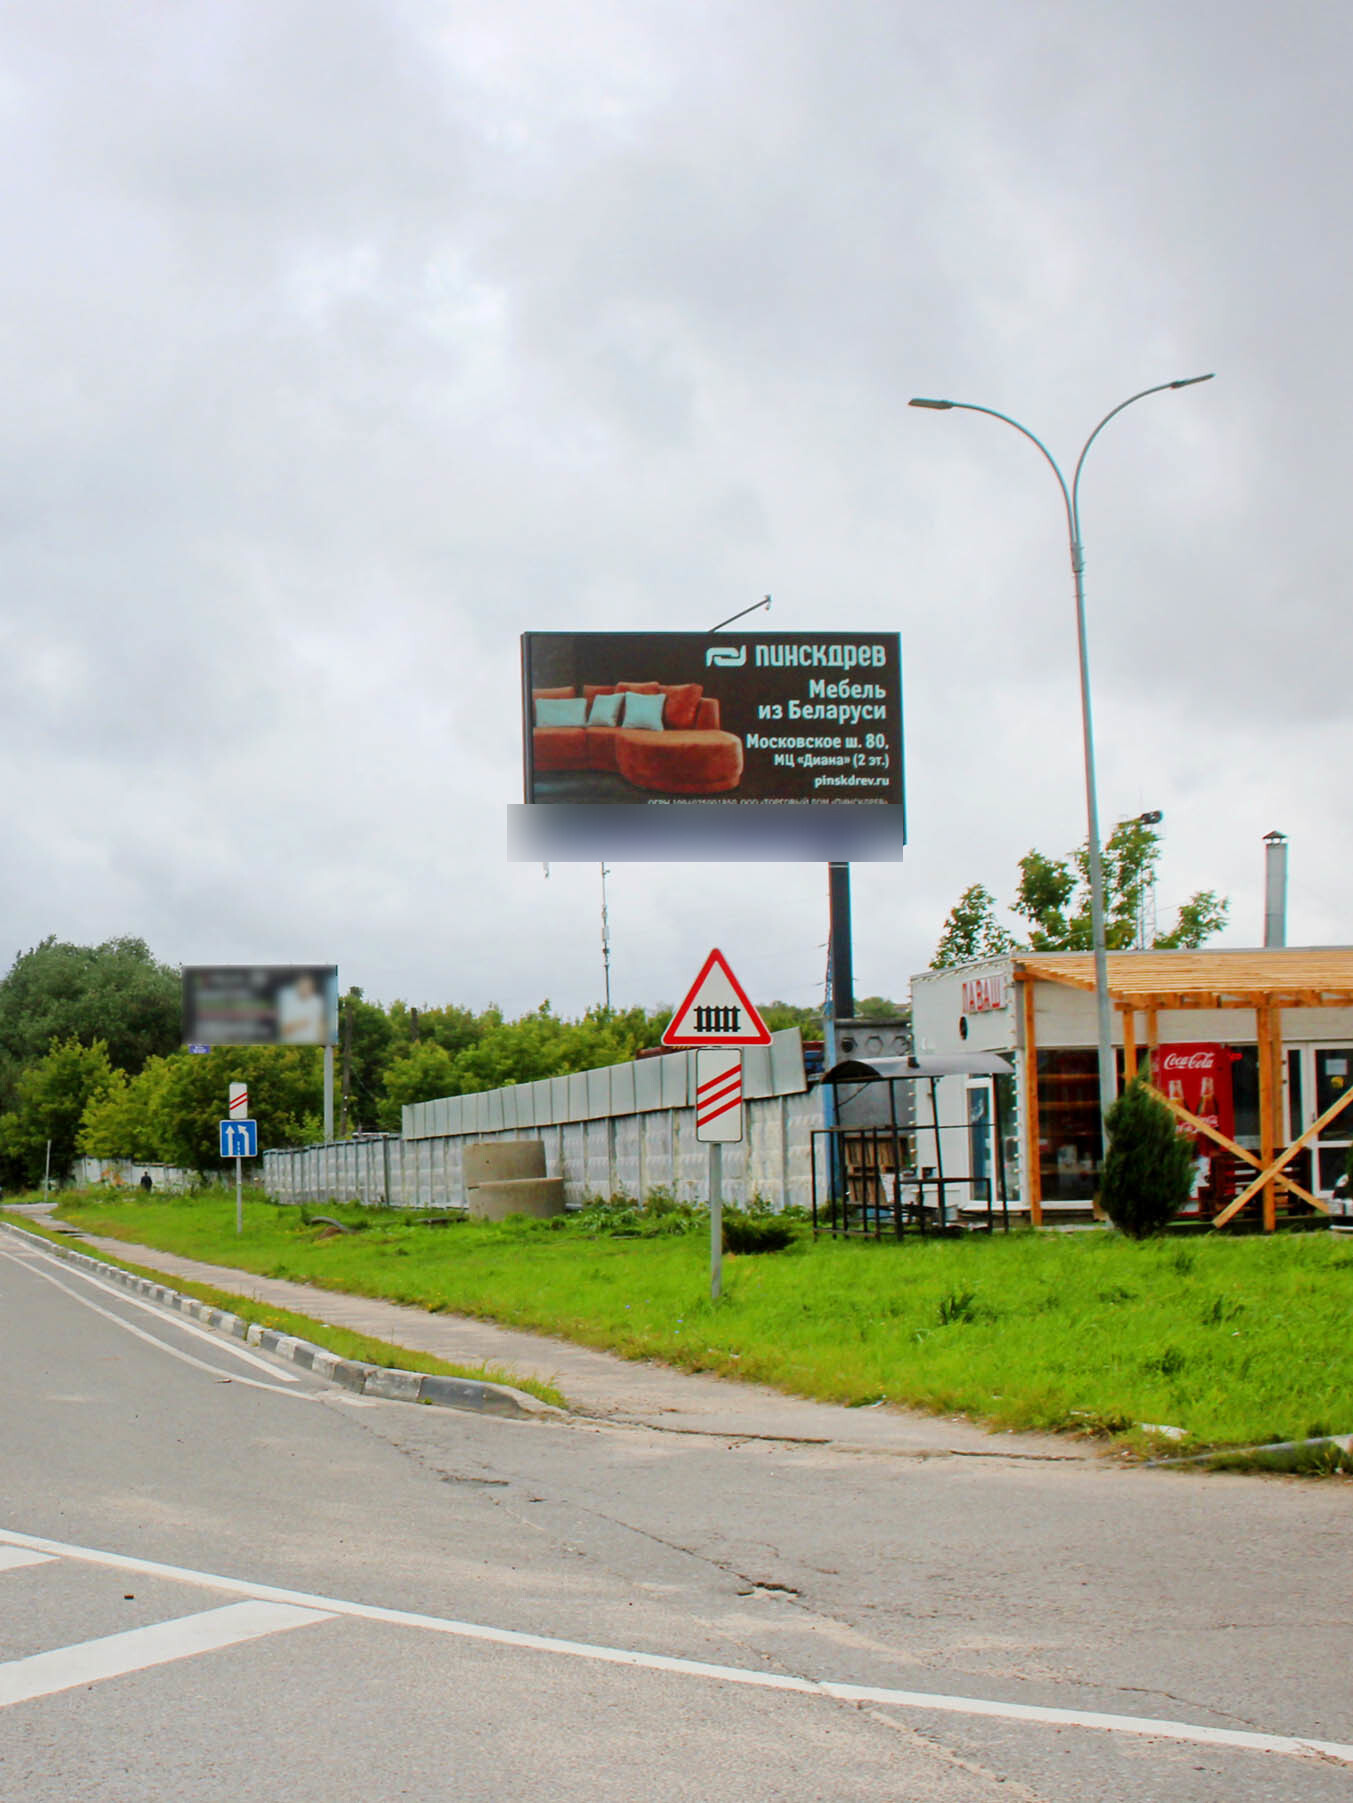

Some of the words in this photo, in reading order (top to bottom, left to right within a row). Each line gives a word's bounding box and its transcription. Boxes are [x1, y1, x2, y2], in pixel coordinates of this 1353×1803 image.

[808, 678, 887, 699] Мебель
[758, 704, 784, 720] из
[787, 700, 887, 725] Беларуси
[745, 733, 842, 749] Московское
[844, 736, 862, 749] ш.
[773, 753, 795, 768] МЦ
[796, 753, 851, 768] «Диана»
[852, 753, 866, 769] (2
[813, 774, 890, 788] pinskdrev.ru
[1164, 1052, 1215, 1070] Coca-Cola
